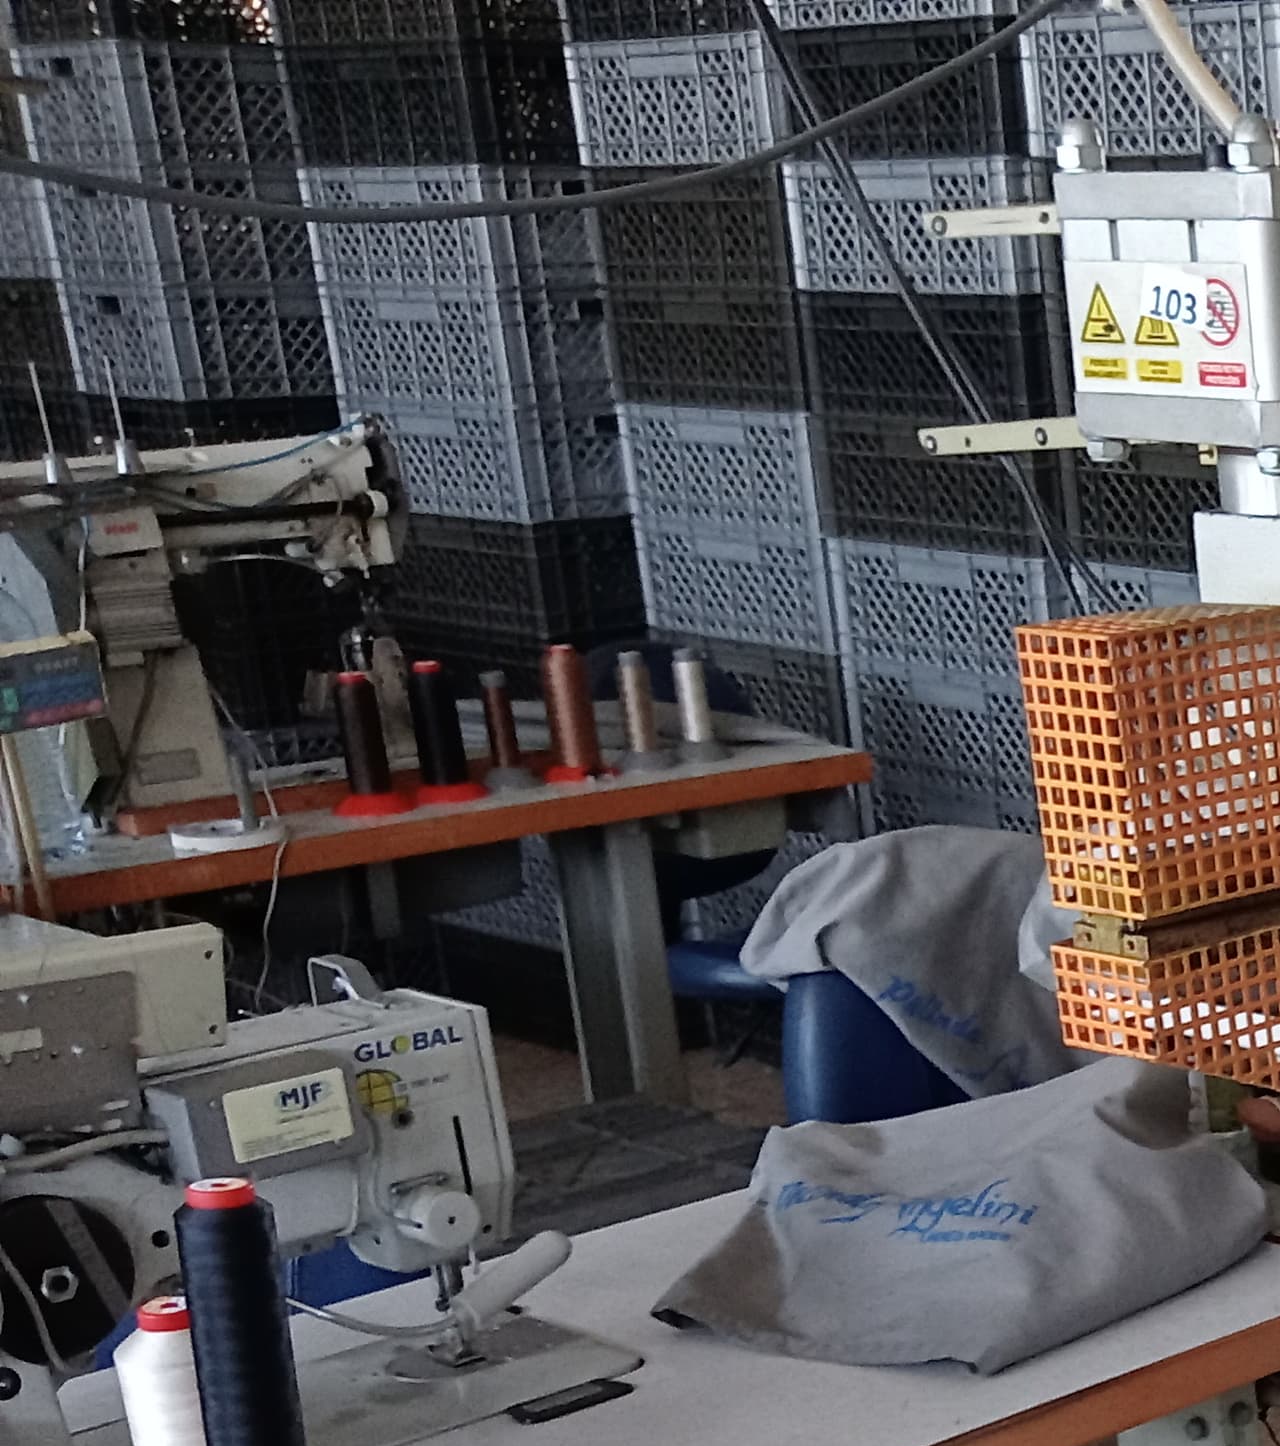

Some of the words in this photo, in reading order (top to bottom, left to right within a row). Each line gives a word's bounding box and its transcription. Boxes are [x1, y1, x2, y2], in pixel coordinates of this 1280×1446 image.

[1149, 285, 1199, 326] 103
[354, 1025, 463, 1063] GLOBAL
[280, 1081, 333, 1110] MJF
